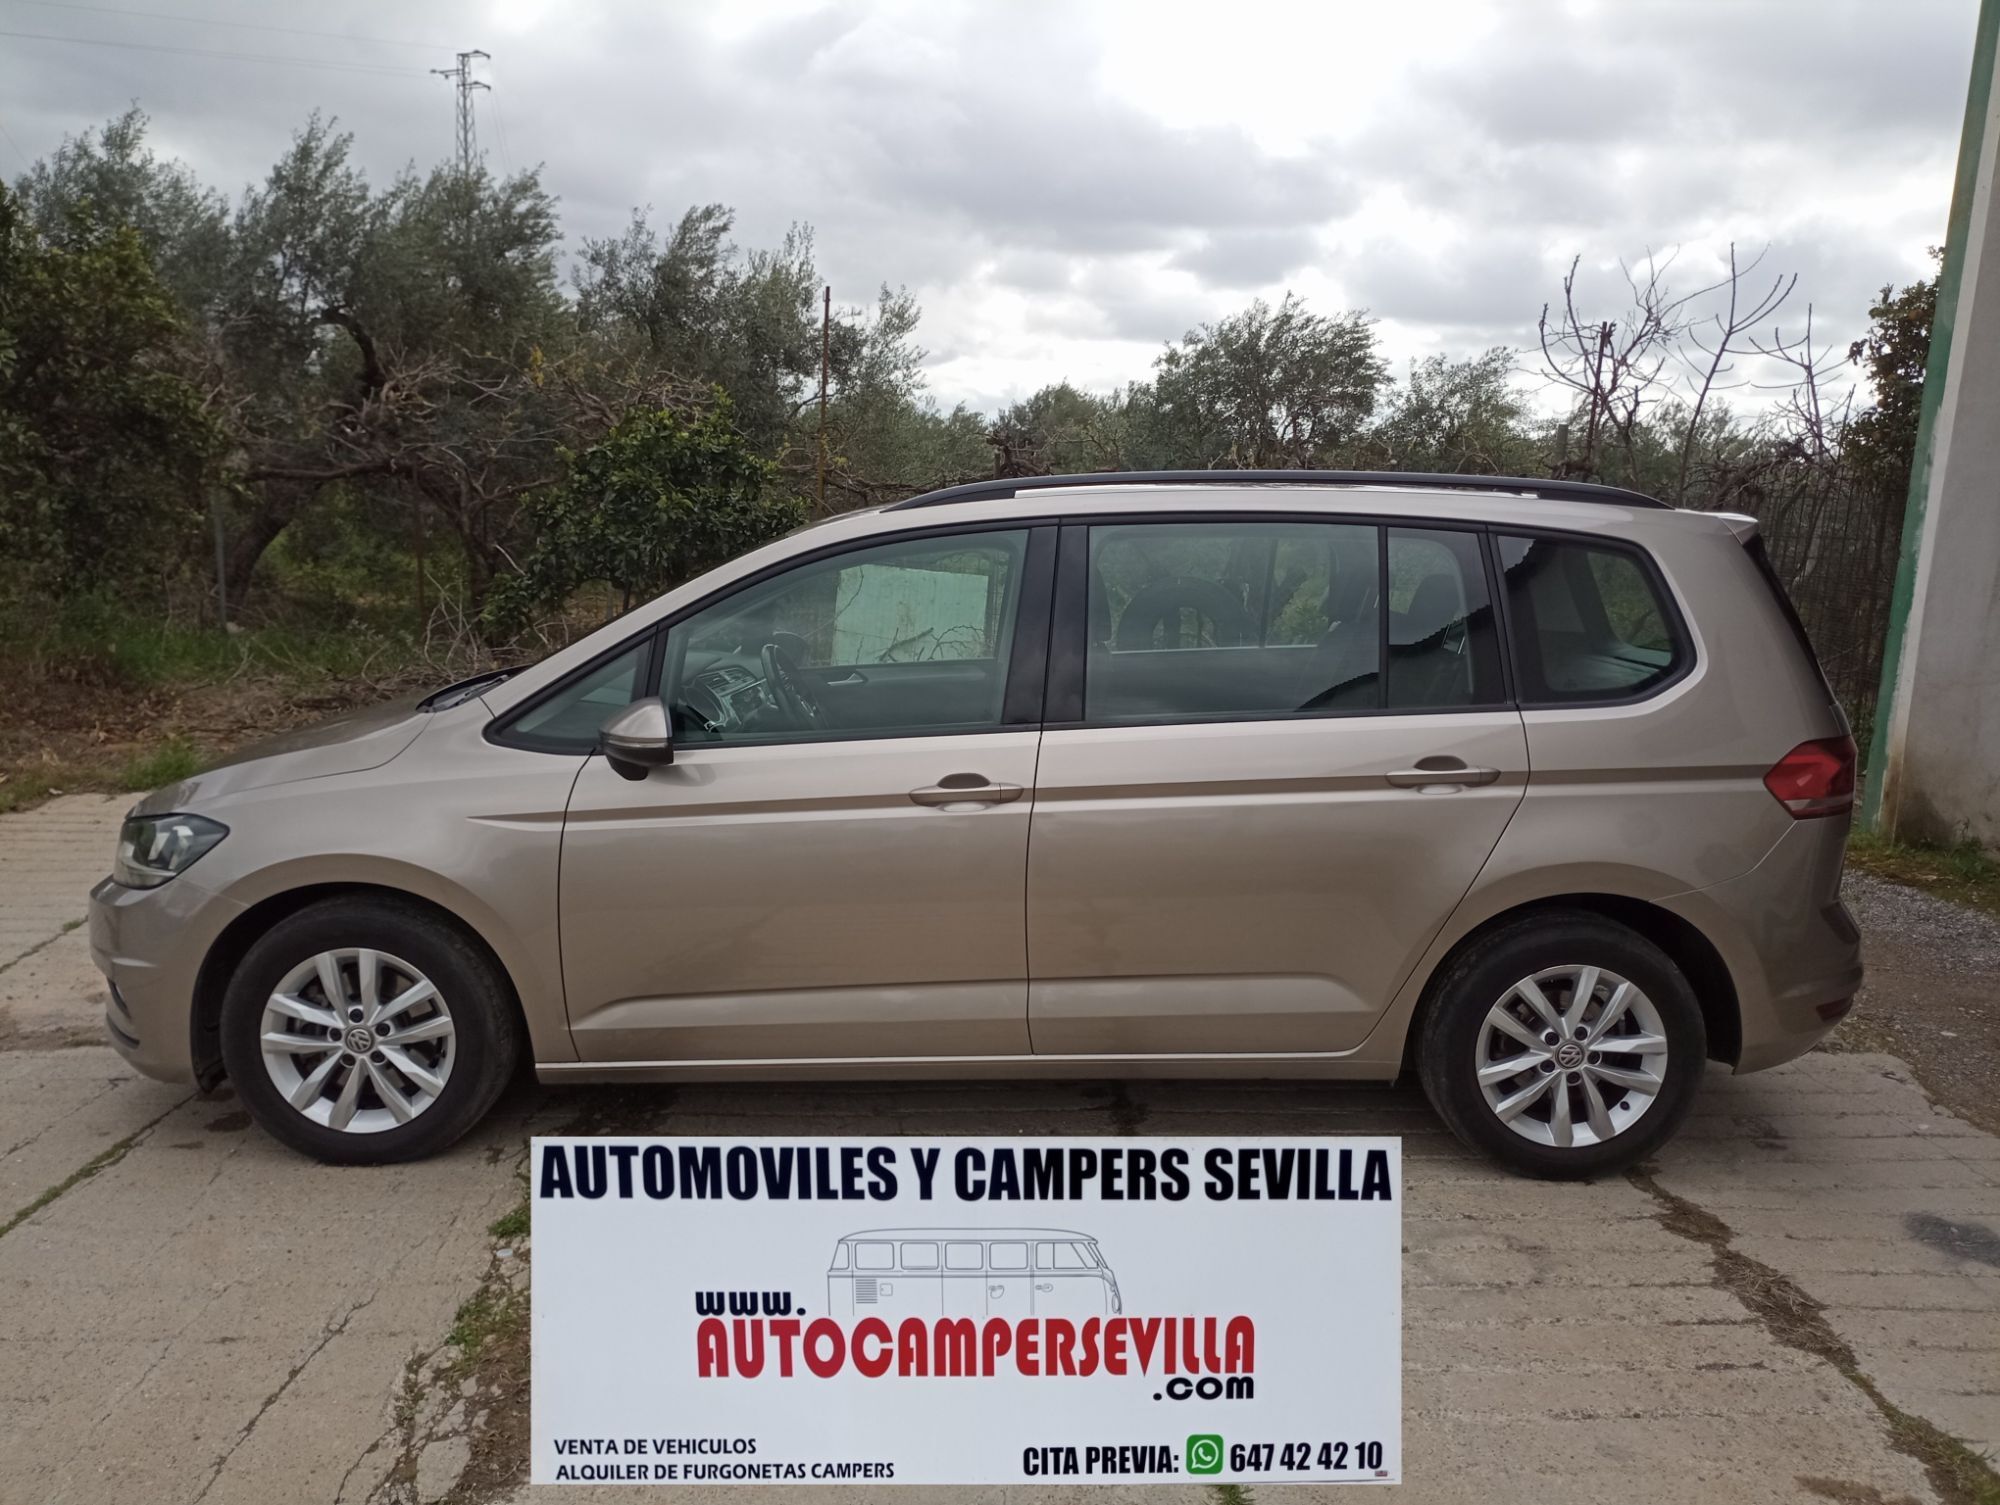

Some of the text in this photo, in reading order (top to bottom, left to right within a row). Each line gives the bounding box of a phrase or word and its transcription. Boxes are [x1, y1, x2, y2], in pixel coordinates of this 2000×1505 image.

[540, 1145, 1392, 1201] AUTOMOVILES Y CAMPERS SEVILLA
[696, 1292, 806, 1316] www.
[698, 1315, 1254, 1379] AUTOCAMPERSEVILLA
[1153, 1377, 1254, 1402] .com
[554, 1439, 756, 1454] VENTA DE VEHICULOS
[1024, 1441, 1382, 1476] CITA PREVIA: 647 42 42 10
[556, 1463, 894, 1480] ALQUILER DE FURGONETAS CAMPERS
